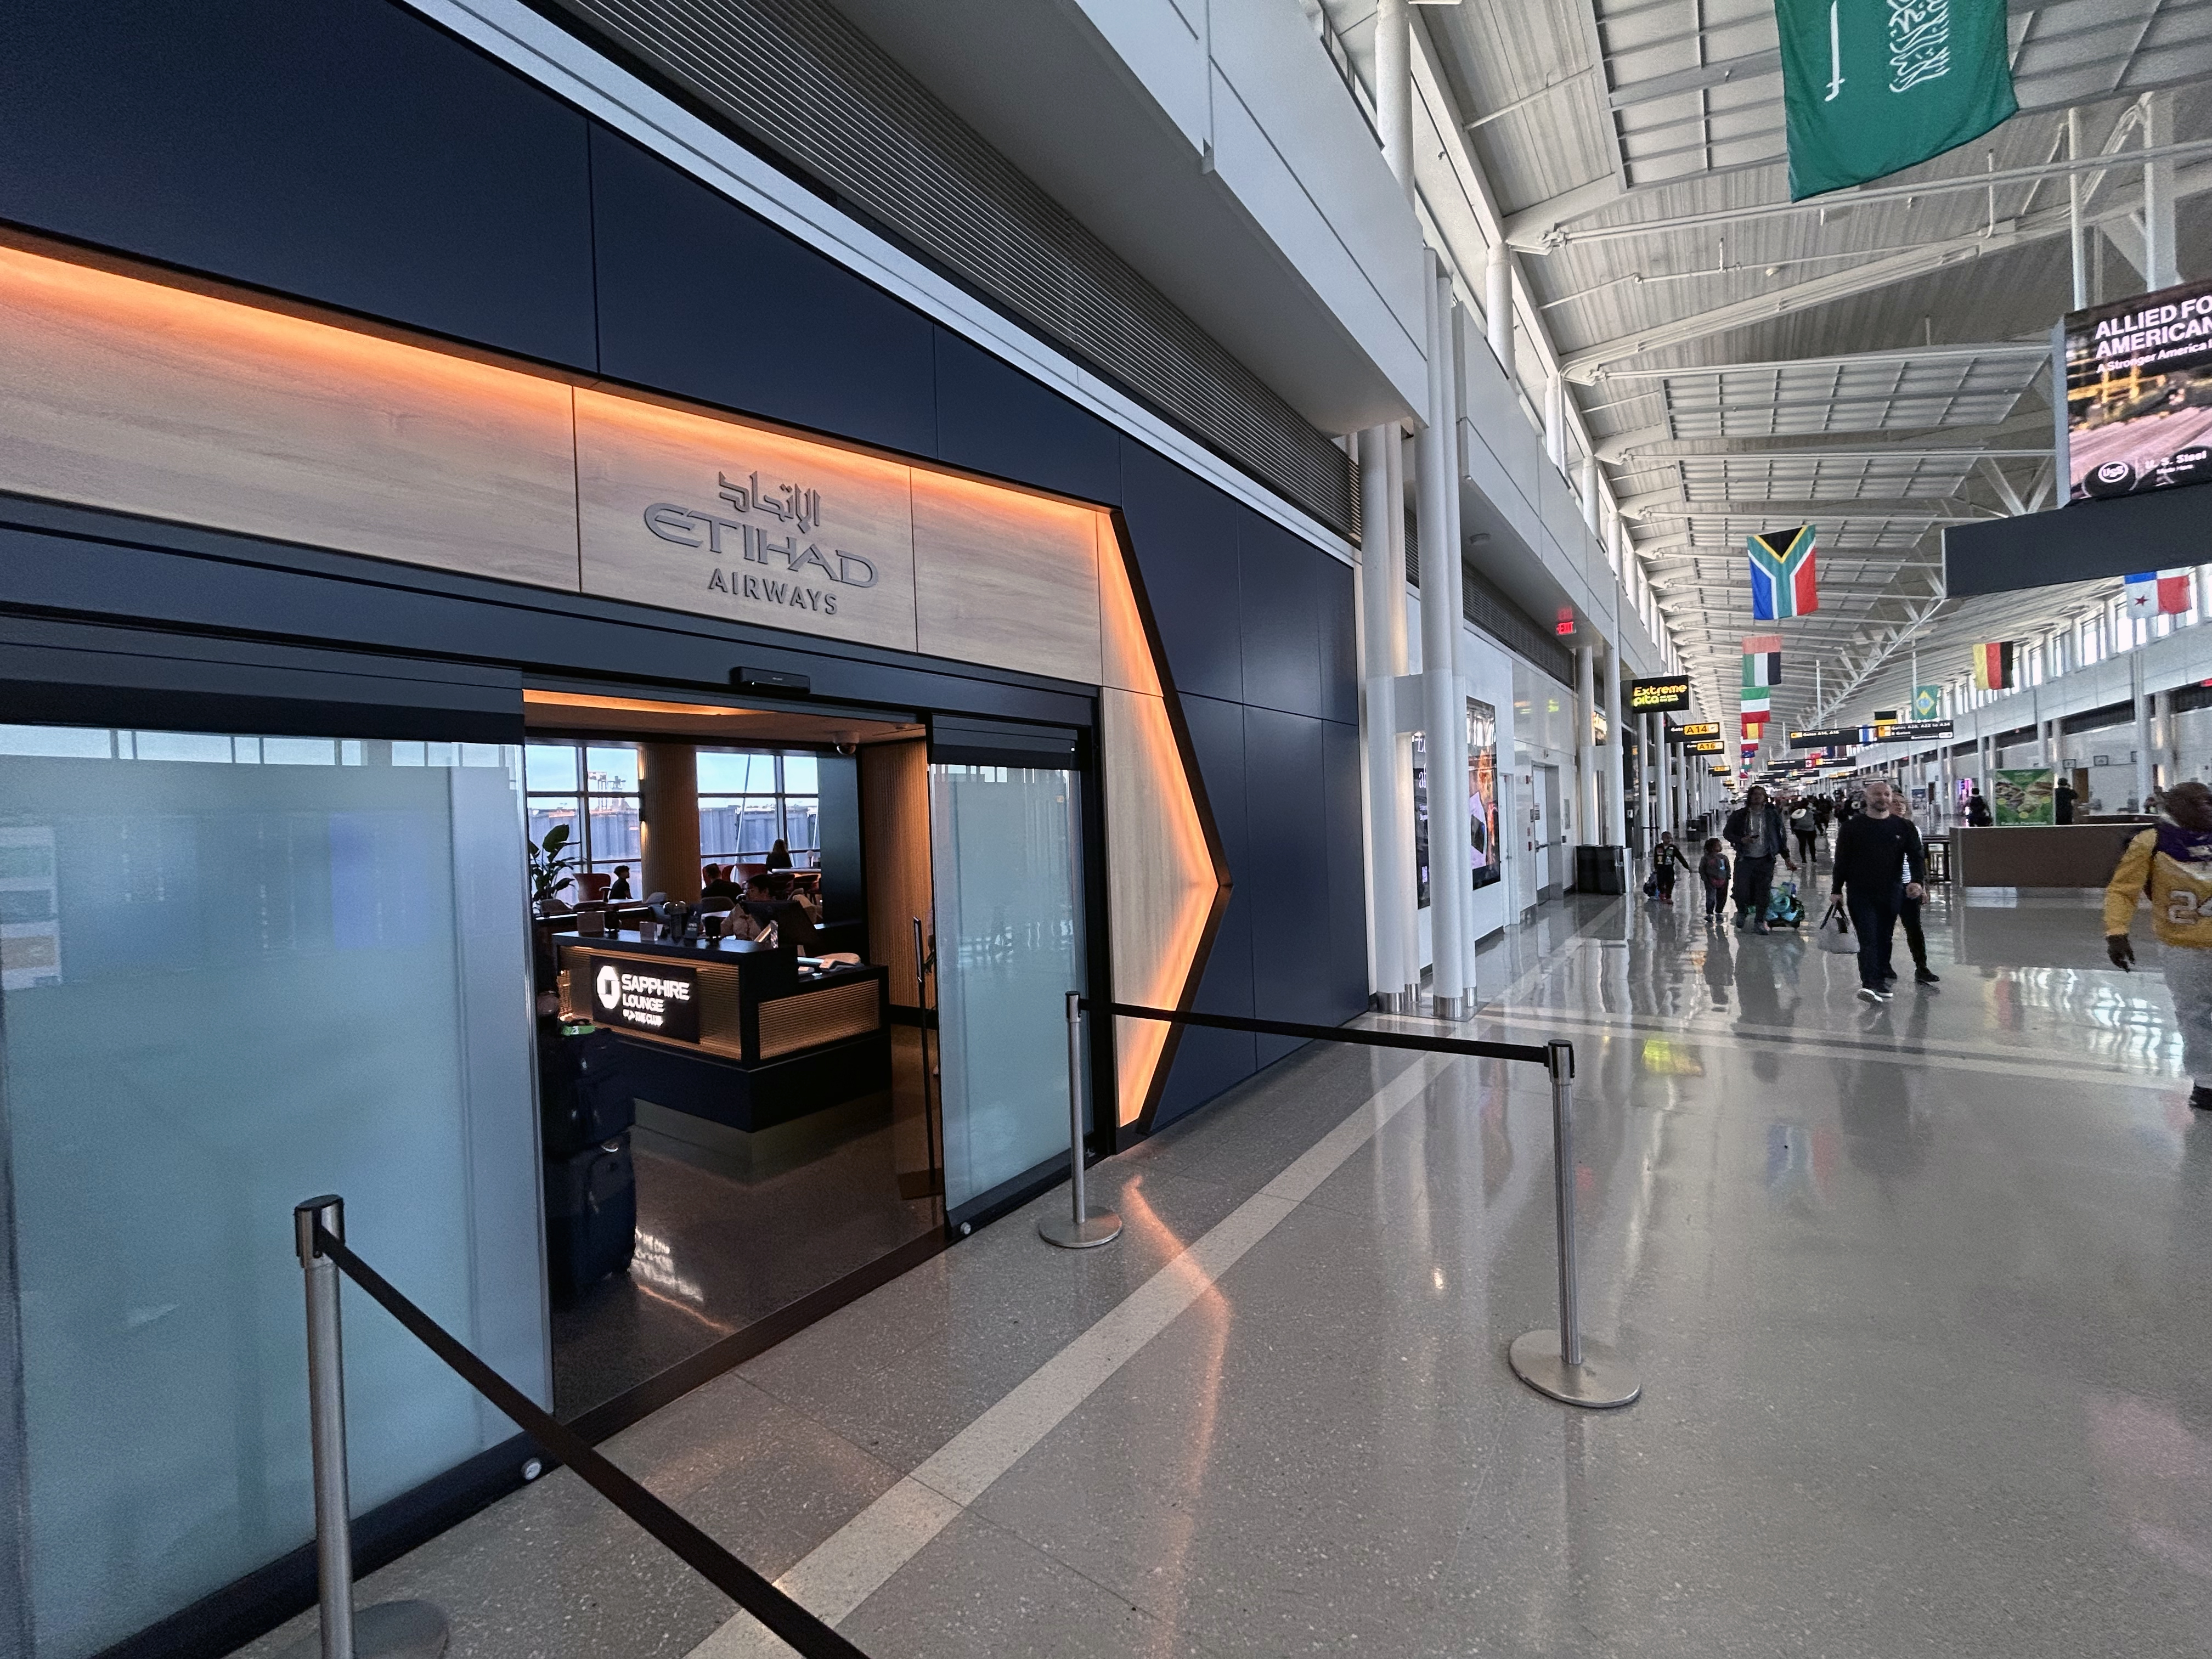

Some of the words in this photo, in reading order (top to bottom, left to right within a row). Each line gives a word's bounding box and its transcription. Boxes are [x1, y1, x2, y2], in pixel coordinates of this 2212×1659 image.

[2095, 305, 2177, 340] ALLIED
[2096, 363, 2107, 374] A
[2107, 354, 2157, 371] Stronger
[2158, 342, 2207, 360] America
[2176, 450, 2207, 464] Steel
[644, 502, 878, 588] ETIHAD
[708, 568, 838, 614] AIRWAYS
[1558, 621, 1574, 635] EXIT
[1633, 695, 1660, 707] pita
[1634, 685, 1688, 697] Extreme
[1686, 725, 1707, 733] A14
[621, 973, 691, 1001] SAPPHIRE
[622, 993, 665, 1013] LOUNGE
